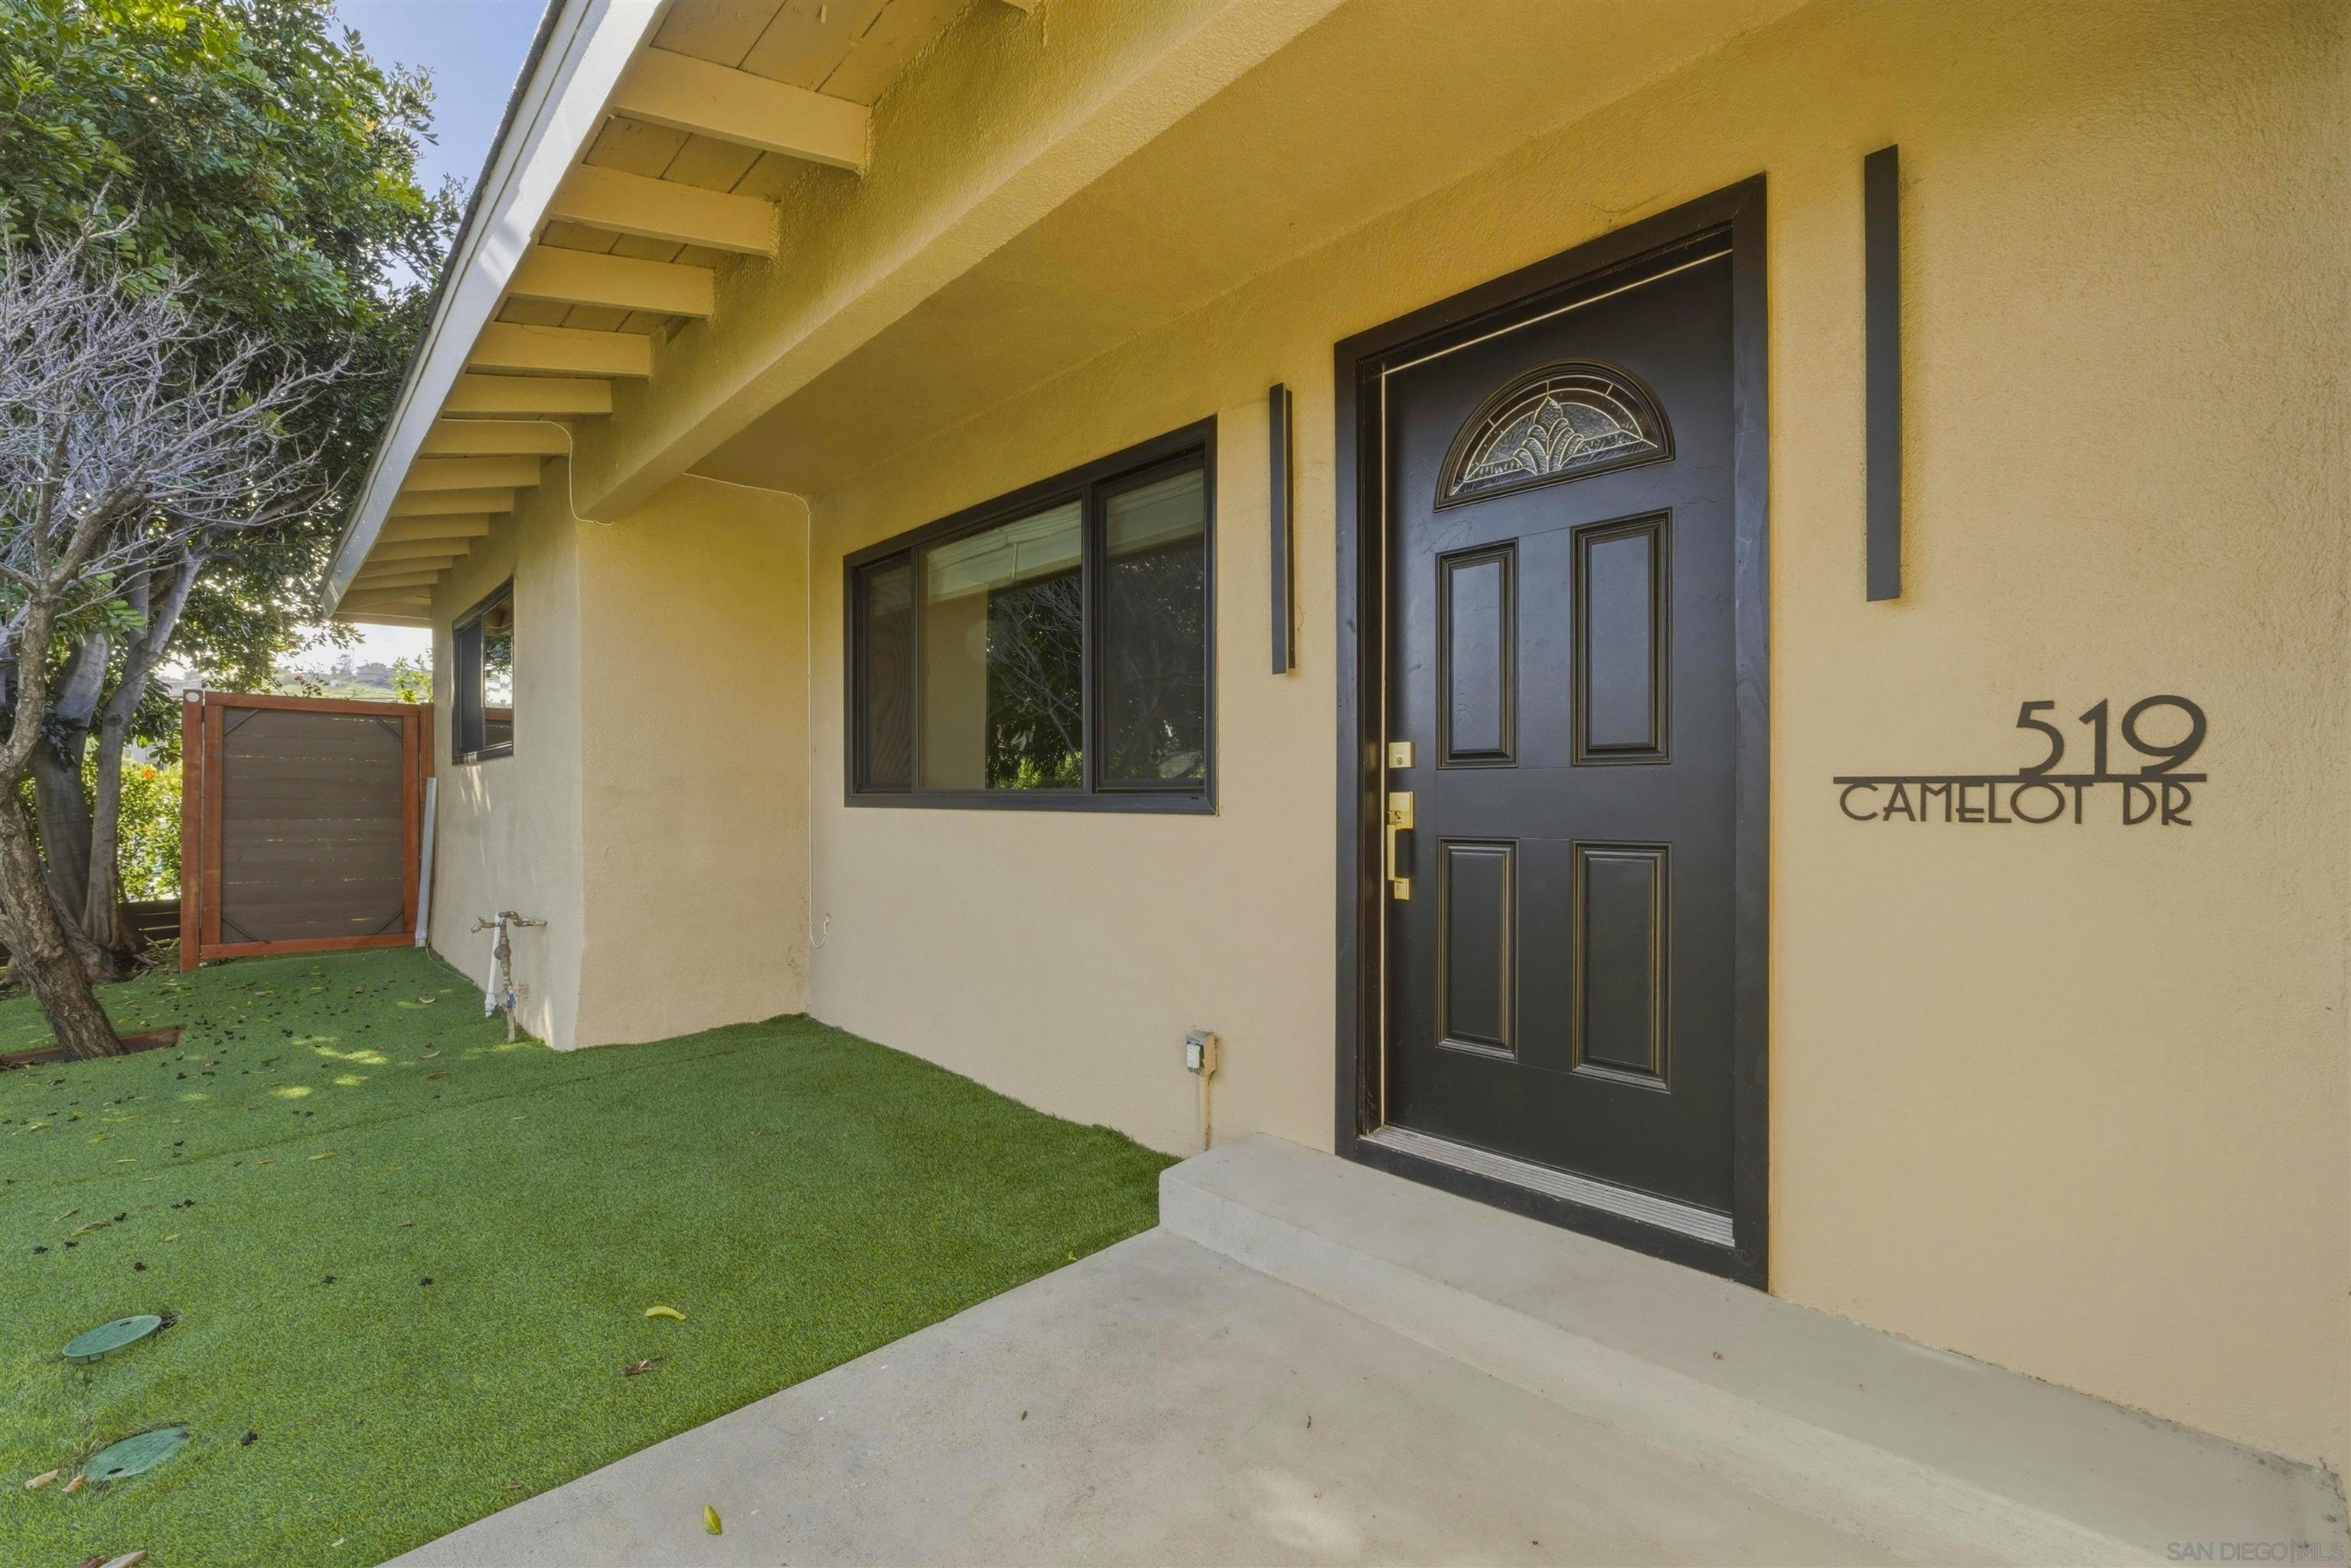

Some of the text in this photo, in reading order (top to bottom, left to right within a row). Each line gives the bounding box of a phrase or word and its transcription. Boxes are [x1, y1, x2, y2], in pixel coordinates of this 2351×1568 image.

[2017, 695, 2206, 777] 519
[1840, 781, 2192, 826] CAMELOT DR
